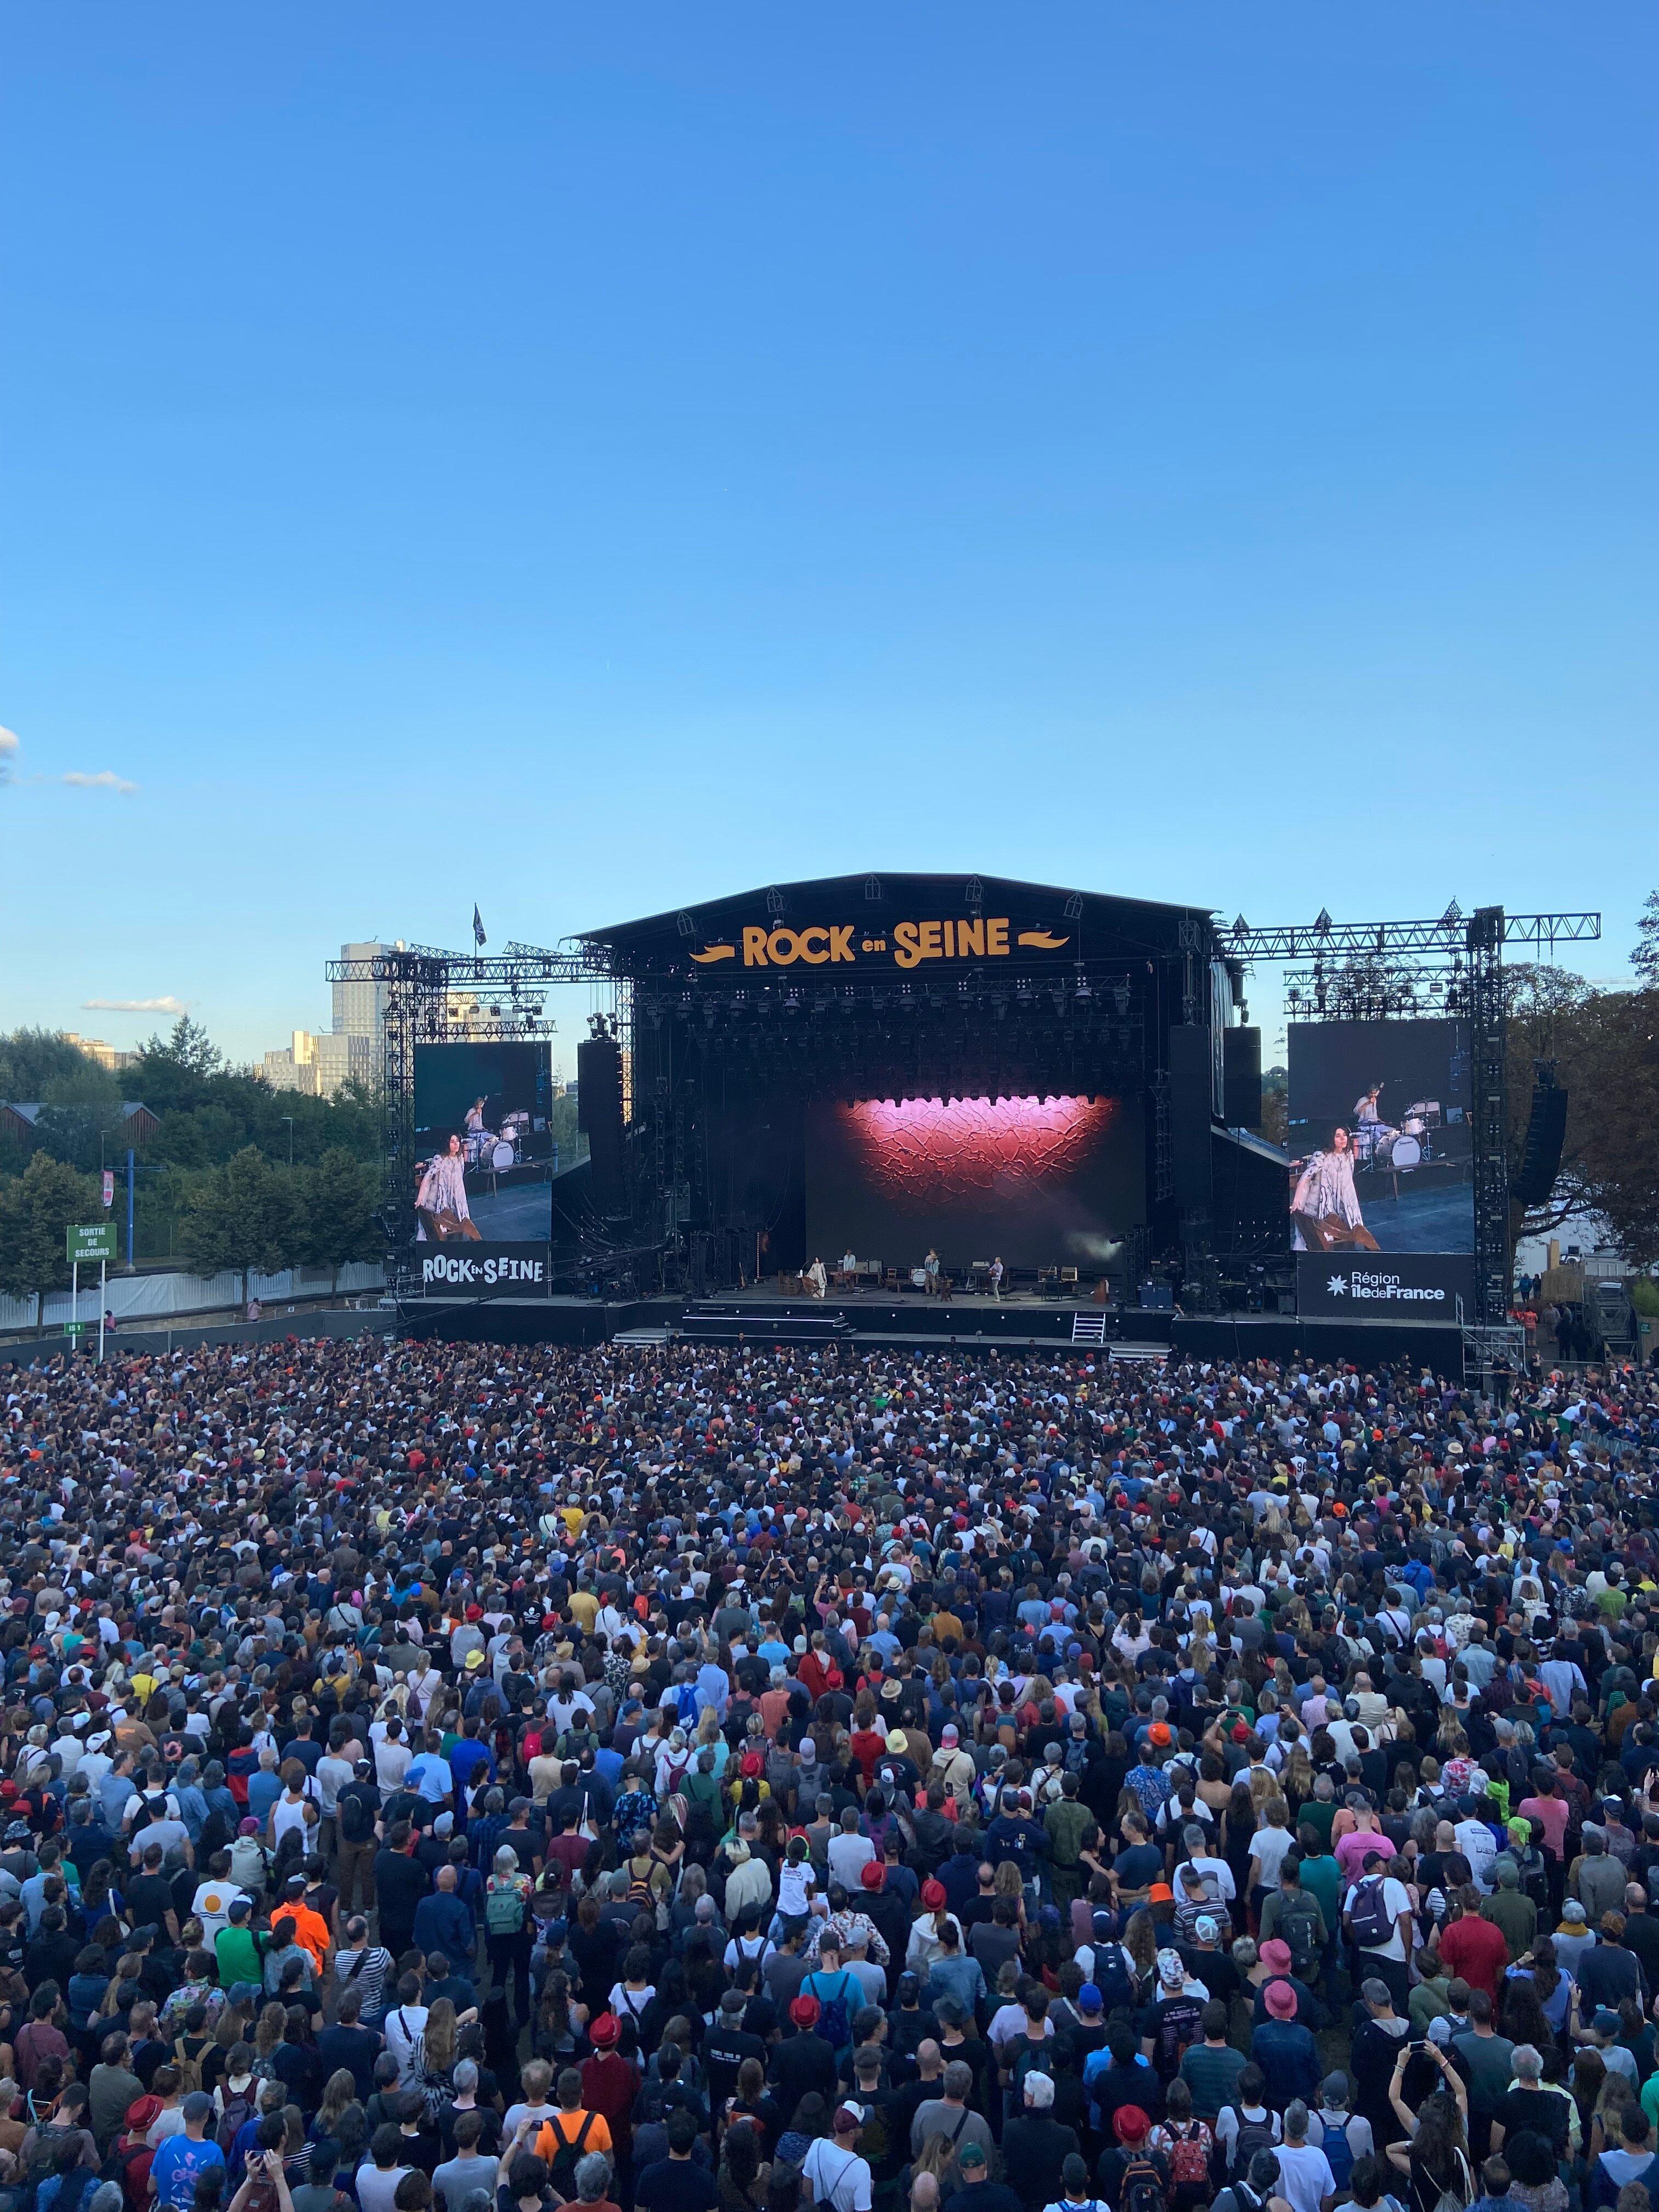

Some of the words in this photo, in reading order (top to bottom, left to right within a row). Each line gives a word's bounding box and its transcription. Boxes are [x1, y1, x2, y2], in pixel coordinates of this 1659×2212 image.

[743, 925, 855, 966] ROCK
[862, 939, 886, 952] en
[894, 918, 1010, 968] SEINE
[79, 1227, 106, 1237] SORTIE
[87, 1238, 98, 1246] DE
[75, 1247, 110, 1257] SECOURS
[422, 1254, 475, 1283] ROCK
[471, 1265, 483, 1274] EN
[483, 1257, 543, 1284] SEINE
[1351, 1271, 1400, 1287] Région
